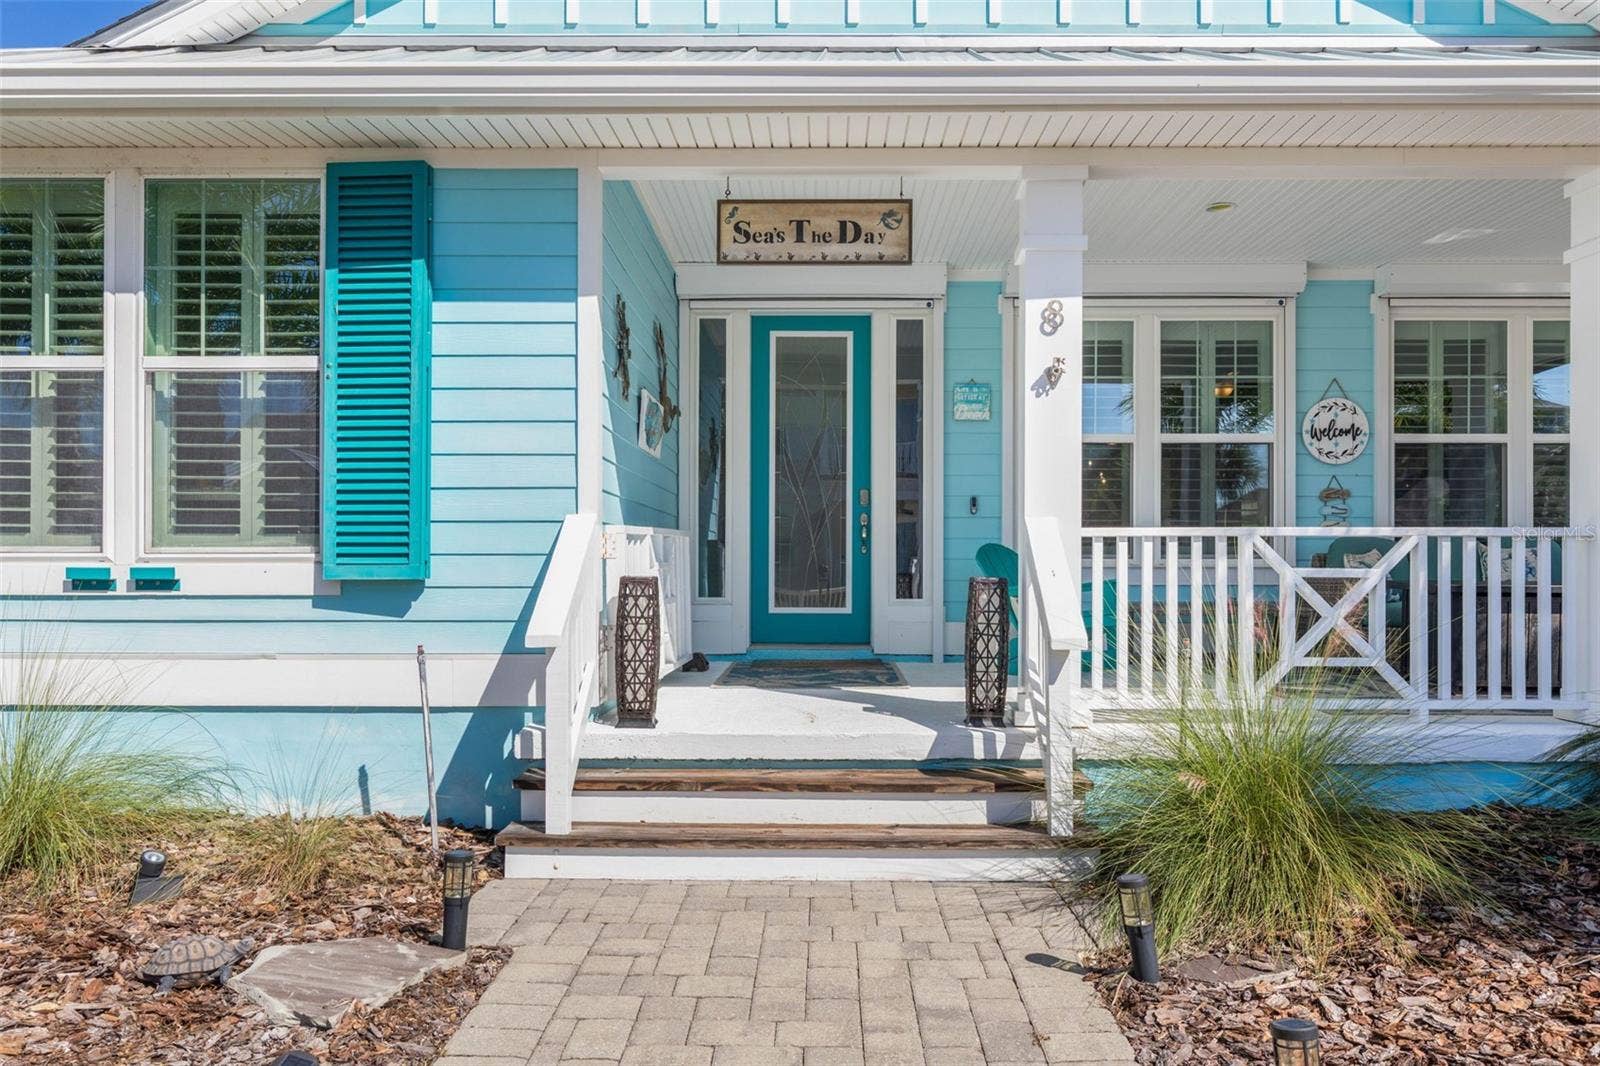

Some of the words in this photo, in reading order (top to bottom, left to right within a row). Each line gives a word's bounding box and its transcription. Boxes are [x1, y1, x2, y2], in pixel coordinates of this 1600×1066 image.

[733, 220, 785, 245] Sea's
[789, 219, 832, 244] The
[836, 220, 886, 245] Day
[1310, 418, 1363, 442] Welcome
